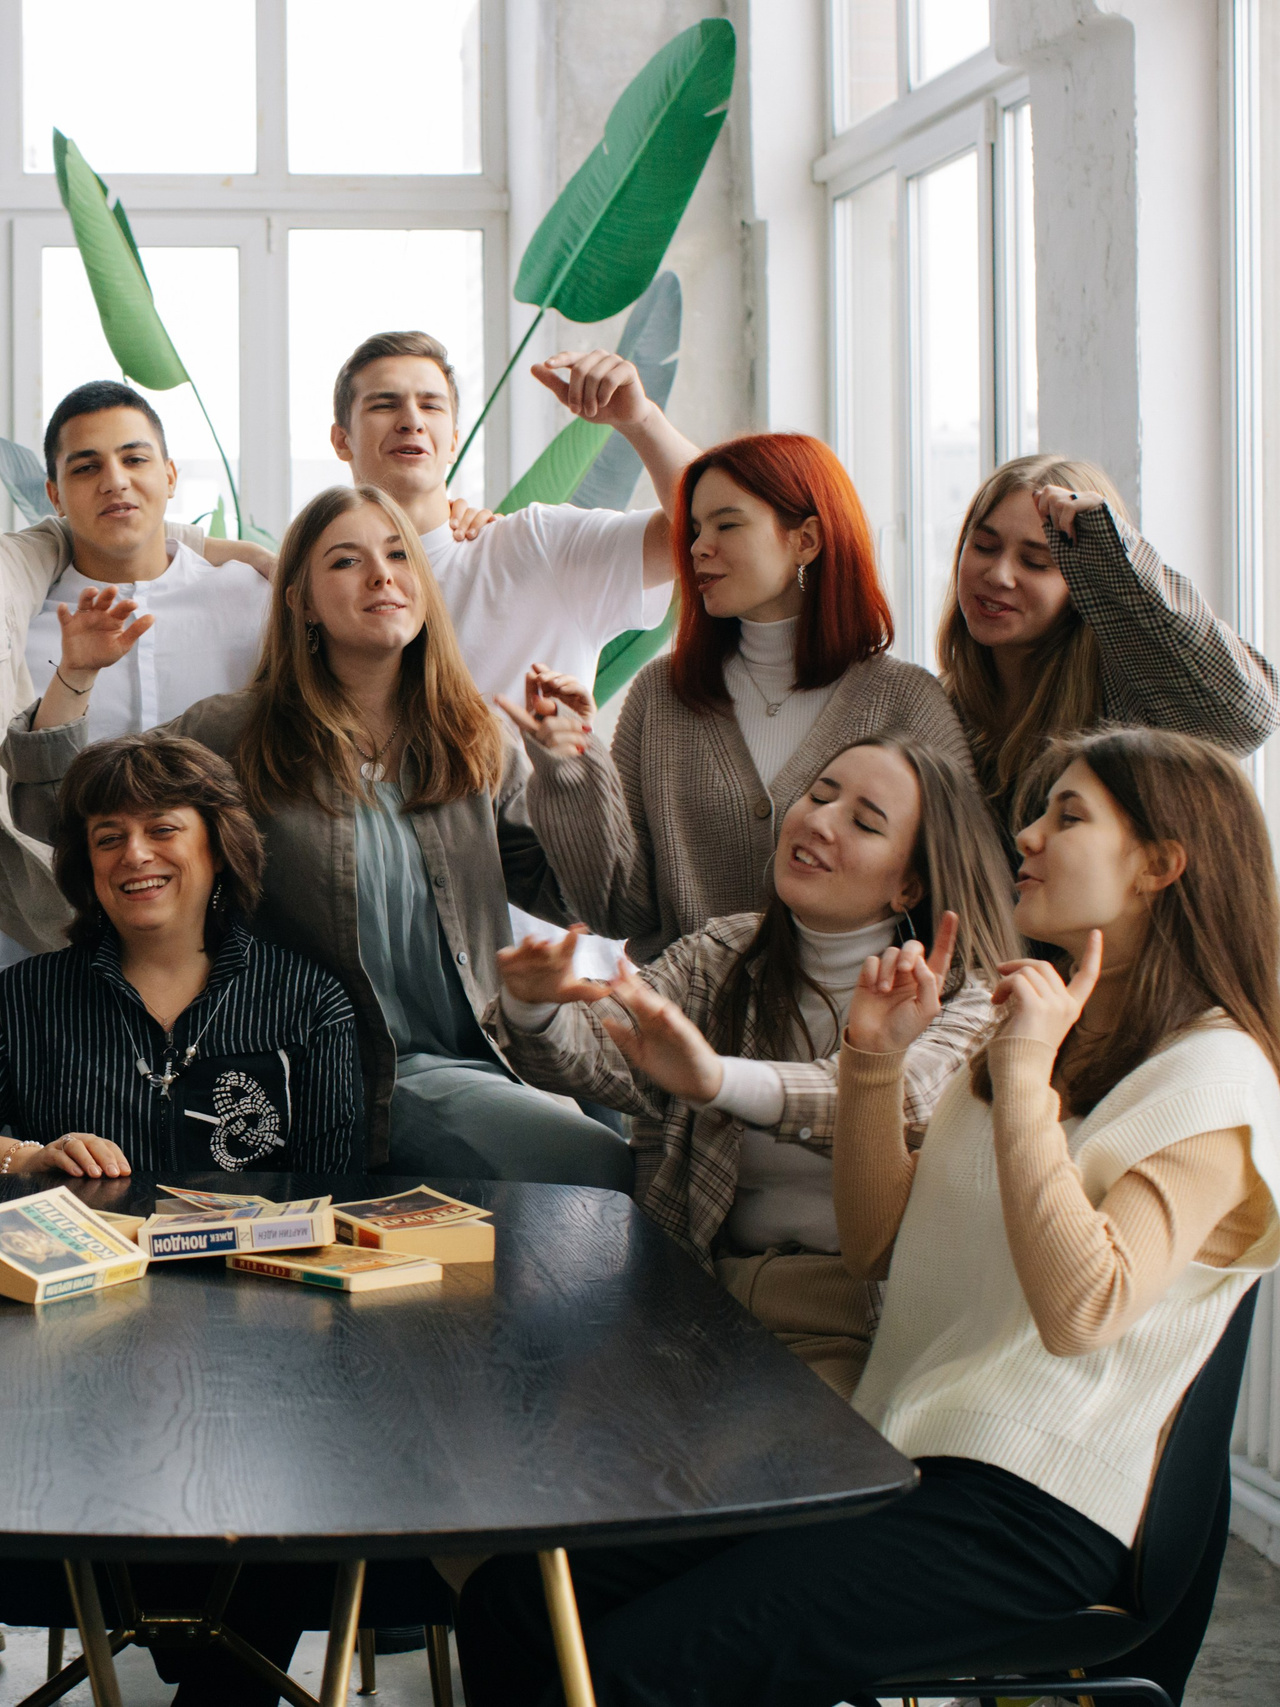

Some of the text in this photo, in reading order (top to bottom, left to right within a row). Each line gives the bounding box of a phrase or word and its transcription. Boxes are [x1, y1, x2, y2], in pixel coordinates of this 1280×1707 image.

[19, 1205, 84, 1251] МАРИЯ
[376, 1206, 464, 1226] ДРАЙЗЕР
[30, 1200, 118, 1260] КОРЕЛЛИ
[153, 1230, 234, 1254] ДЖЕК ЛОНДОН
[258, 1227, 308, 1240] МАРТИН ИДЕН
